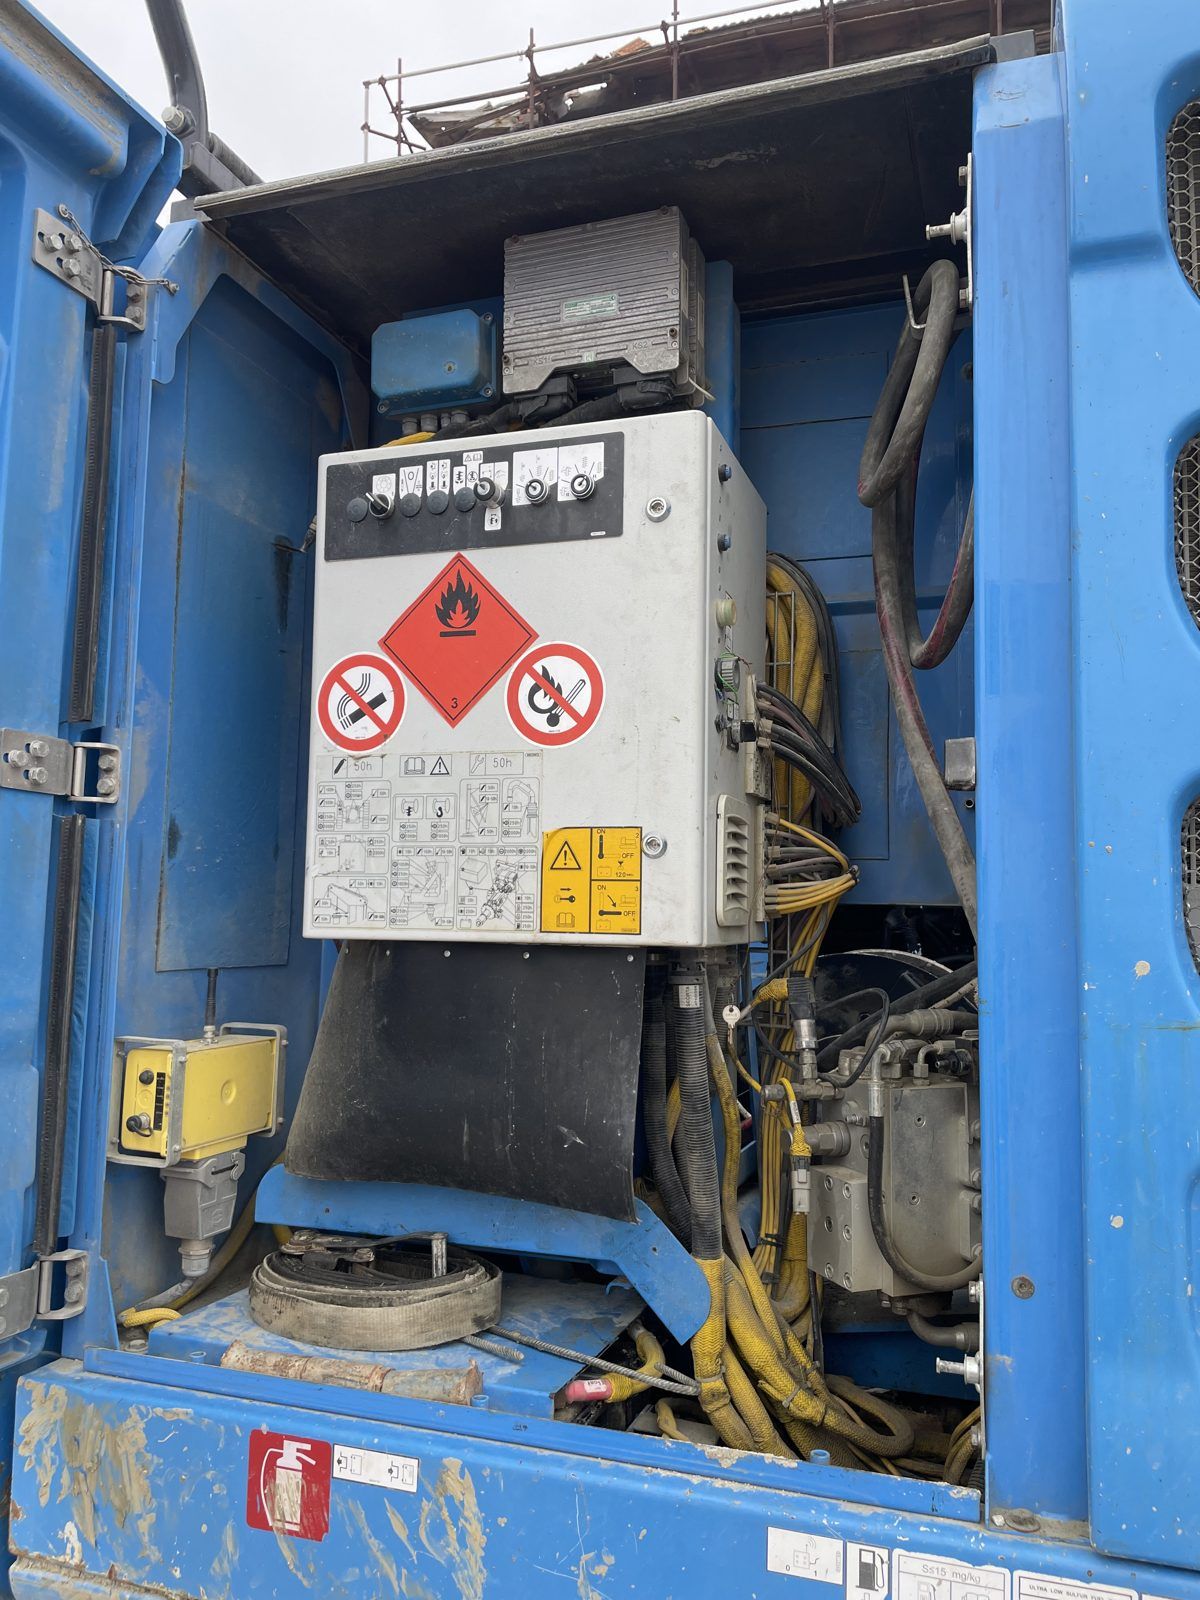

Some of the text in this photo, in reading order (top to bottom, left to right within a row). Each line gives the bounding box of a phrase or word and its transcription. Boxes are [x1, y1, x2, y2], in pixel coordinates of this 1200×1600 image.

[632, 341, 648, 350] KS2
[451, 697, 458, 709] 3
[354, 760, 373, 771] 50h
[493, 757, 512, 768] 50h
[951, 1570, 981, 1584] mg/kg
[1029, 1585, 1048, 1593] ULTRA
[1065, 1590, 1088, 1599] SULFUR
